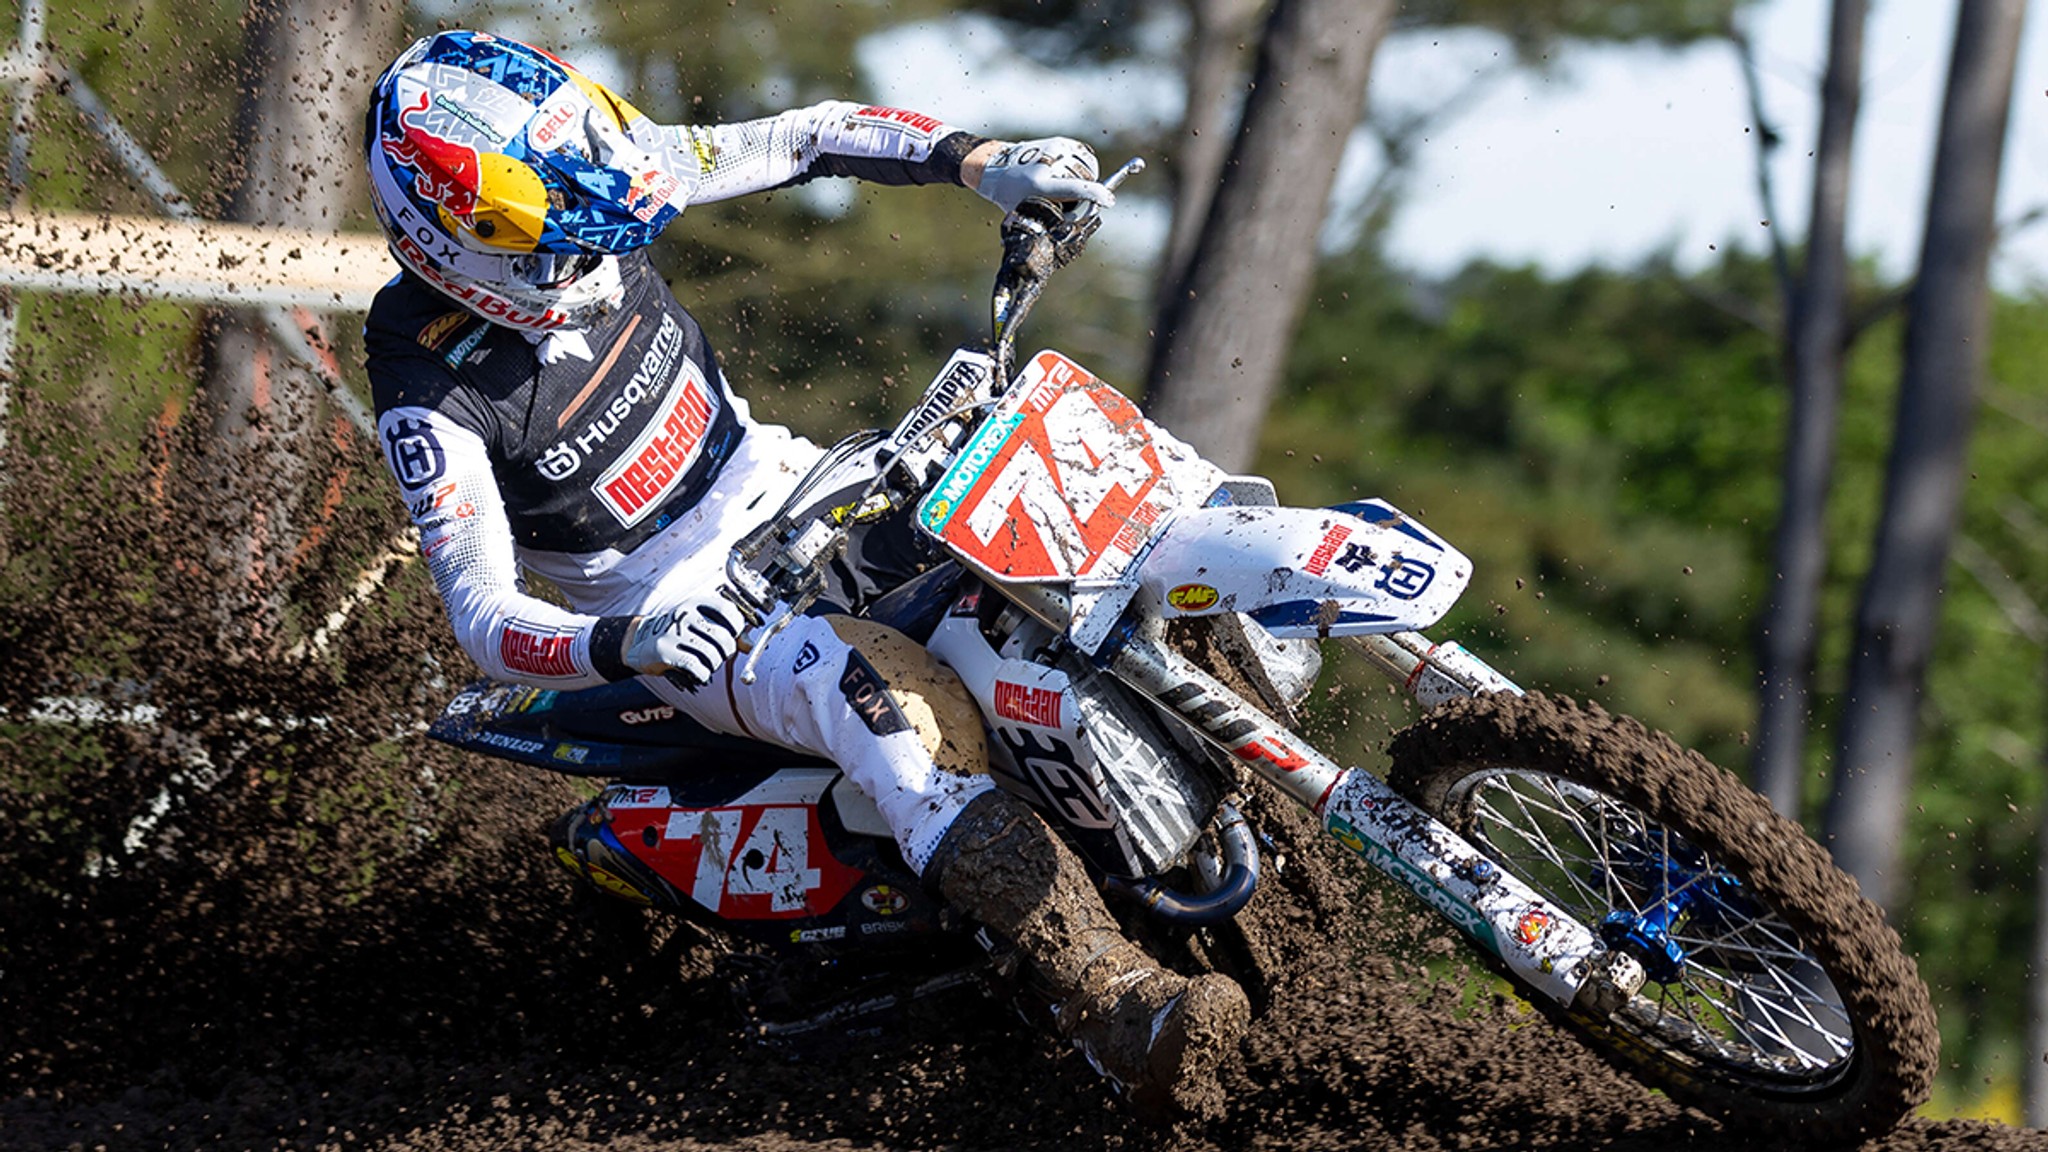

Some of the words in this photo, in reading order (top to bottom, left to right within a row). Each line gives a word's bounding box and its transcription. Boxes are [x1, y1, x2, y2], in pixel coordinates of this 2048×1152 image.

[535, 106, 573, 145] BELL
[636, 192, 666, 221] Red
[659, 175, 681, 200] Bull
[398, 207, 460, 265] FOX
[398, 236, 474, 302] Red
[476, 294, 568, 329] Bull
[577, 312, 676, 455] Husqvarna
[904, 362, 979, 445] PROTAPER
[1028, 360, 1075, 413] MX2
[605, 379, 713, 517] nestaan
[941, 417, 1016, 501] MOTOREX
[966, 385, 1165, 577] 74
[1168, 586, 1217, 608] FMF
[619, 704, 676, 725] GUTS
[843, 667, 891, 723] FOX
[994, 679, 1062, 729] nestaan
[478, 730, 545, 754] DUNLOP
[664, 808, 821, 912] 74
[1365, 845, 1482, 935] MOTOREX
[860, 920, 906, 935] BRISK
